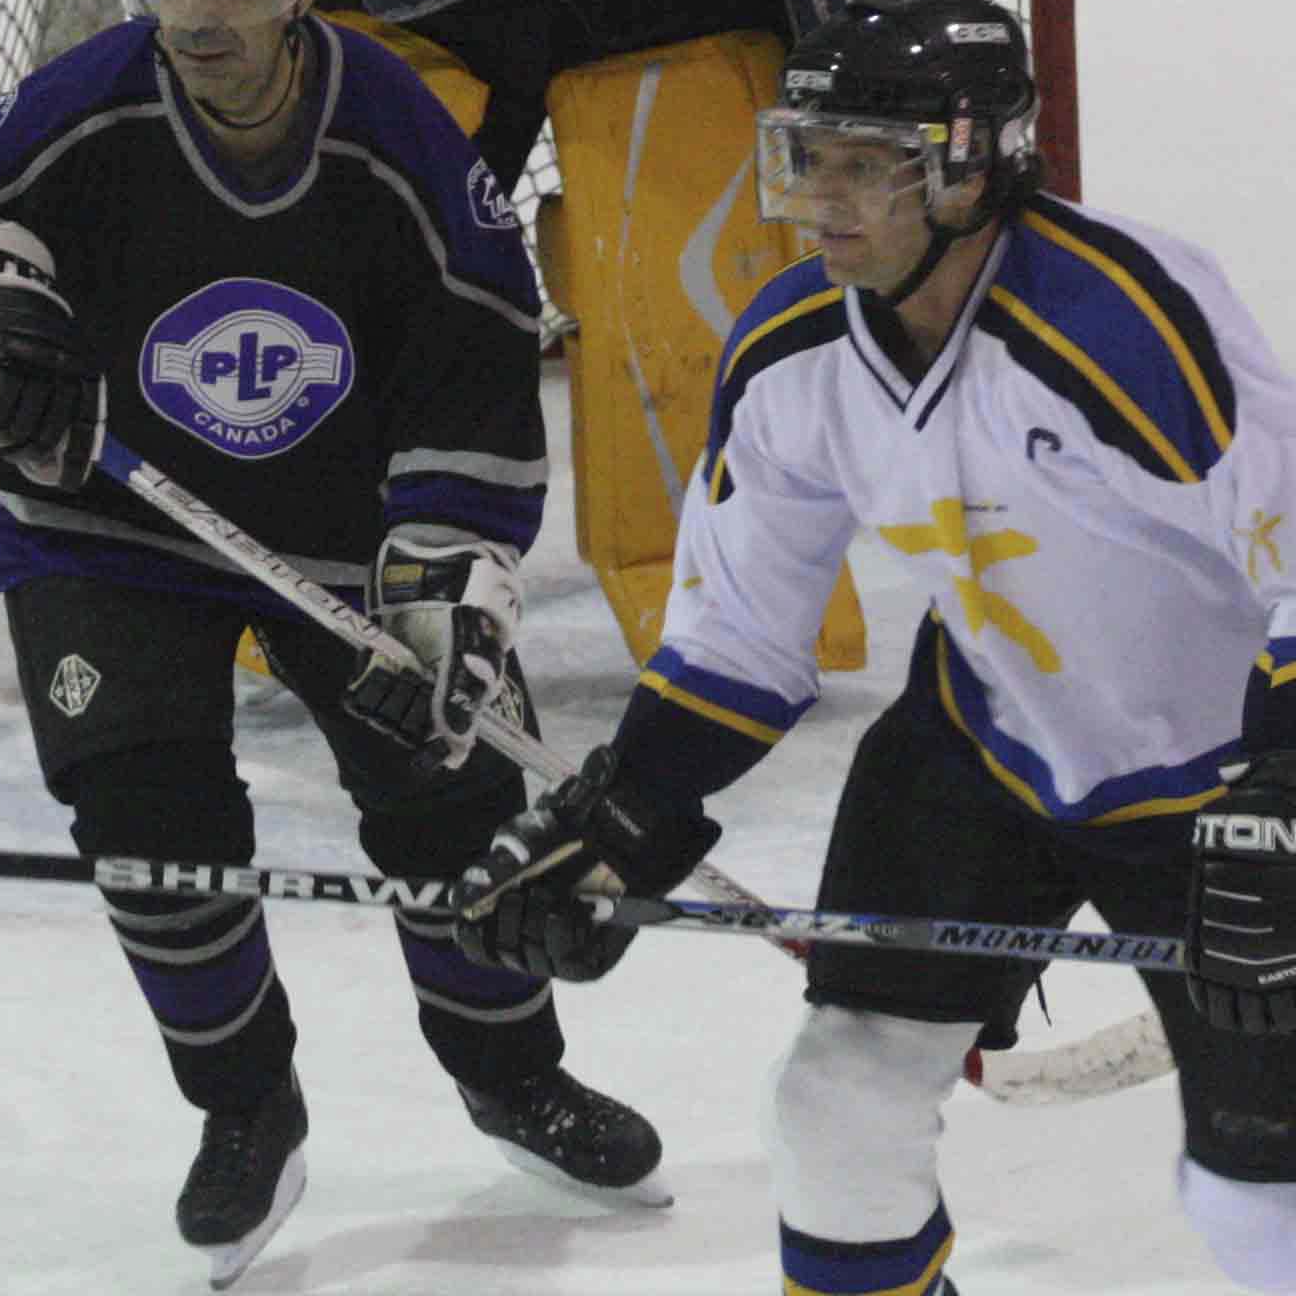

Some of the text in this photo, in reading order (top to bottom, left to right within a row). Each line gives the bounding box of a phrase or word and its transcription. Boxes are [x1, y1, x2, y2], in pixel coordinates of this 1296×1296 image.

[199, 331, 300, 402] PLP
[193, 410, 297, 445] CANADA
[93, 856, 455, 909] SHER-W
